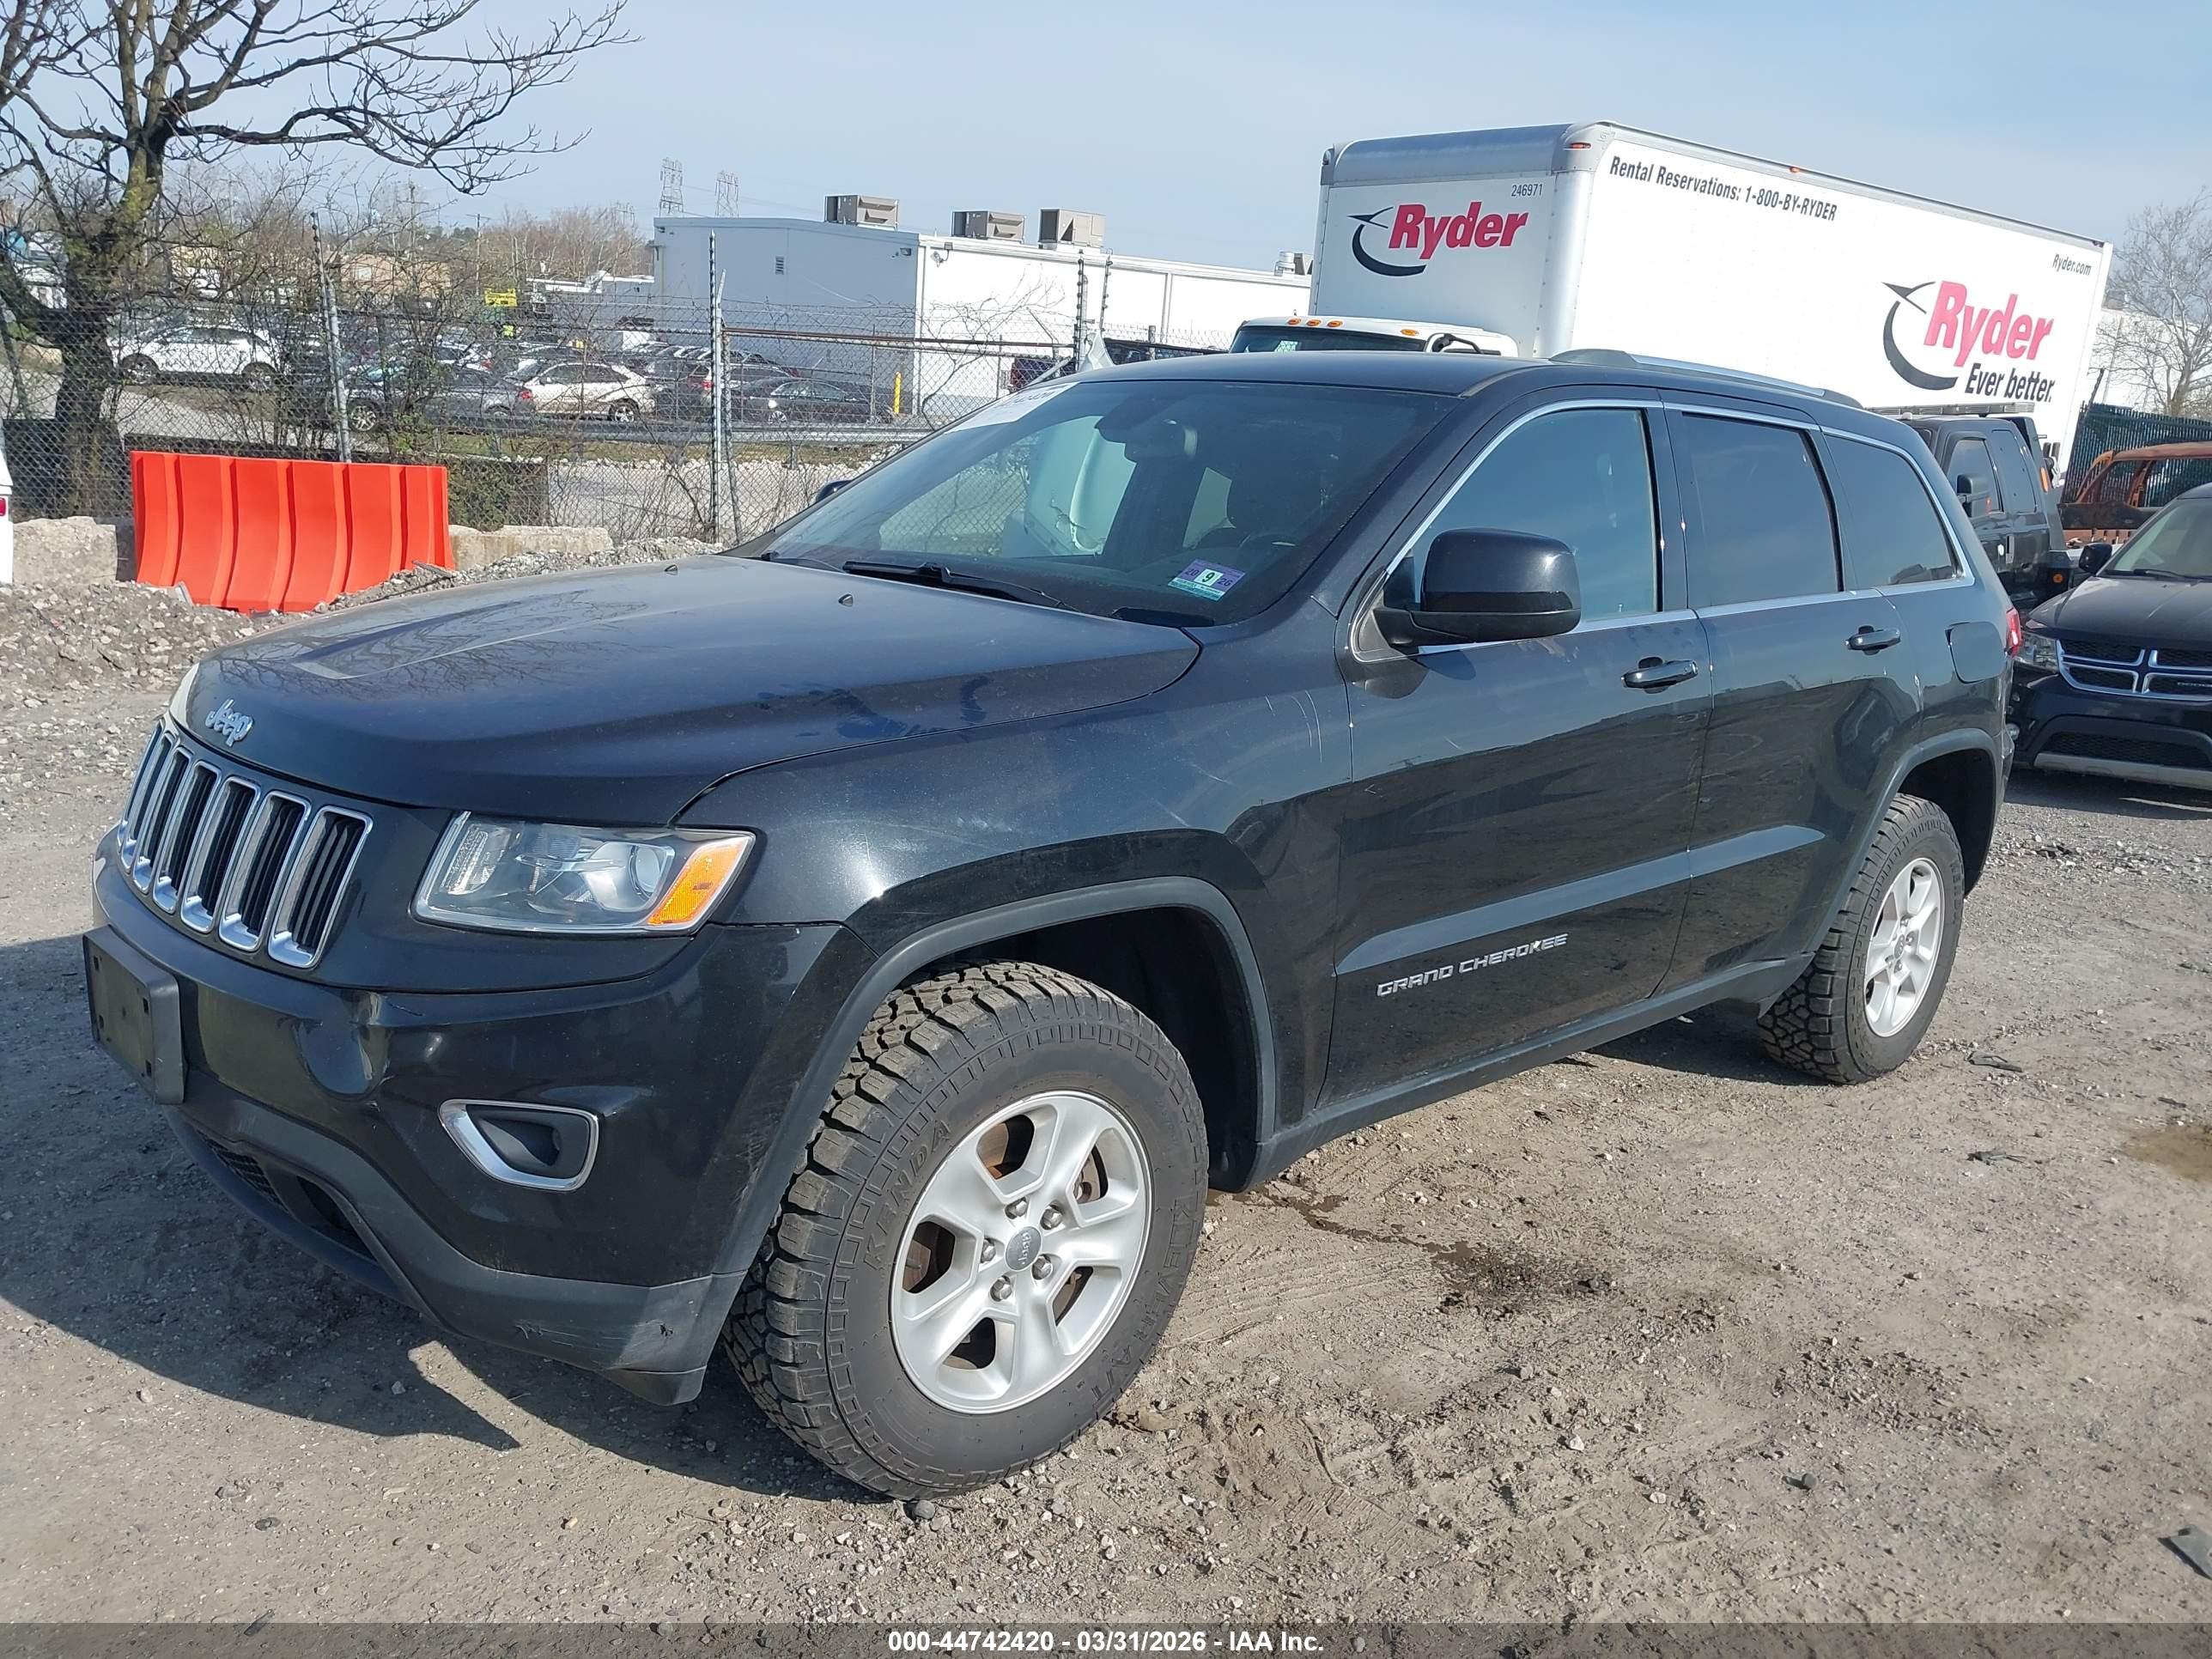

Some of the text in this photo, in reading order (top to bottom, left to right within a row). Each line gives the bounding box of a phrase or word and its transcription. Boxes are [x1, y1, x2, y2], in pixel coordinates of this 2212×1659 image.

[1510, 183, 1543, 197] 246971
[1609, 155, 1838, 222] Rental Reservations: 1-800-BY-RYDER
[1388, 201, 1530, 260] Ryder
[2052, 254, 2092, 276] Ryder.com
[1923, 280, 2055, 368] Ryder
[1964, 362, 2057, 403] Ever better.
[1201, 572, 1215, 583] 9
[205, 698, 254, 747] Jeep
[1376, 933, 1569, 997] GRAND CHEROKEE
[864, 1118, 952, 1272] KENDA
